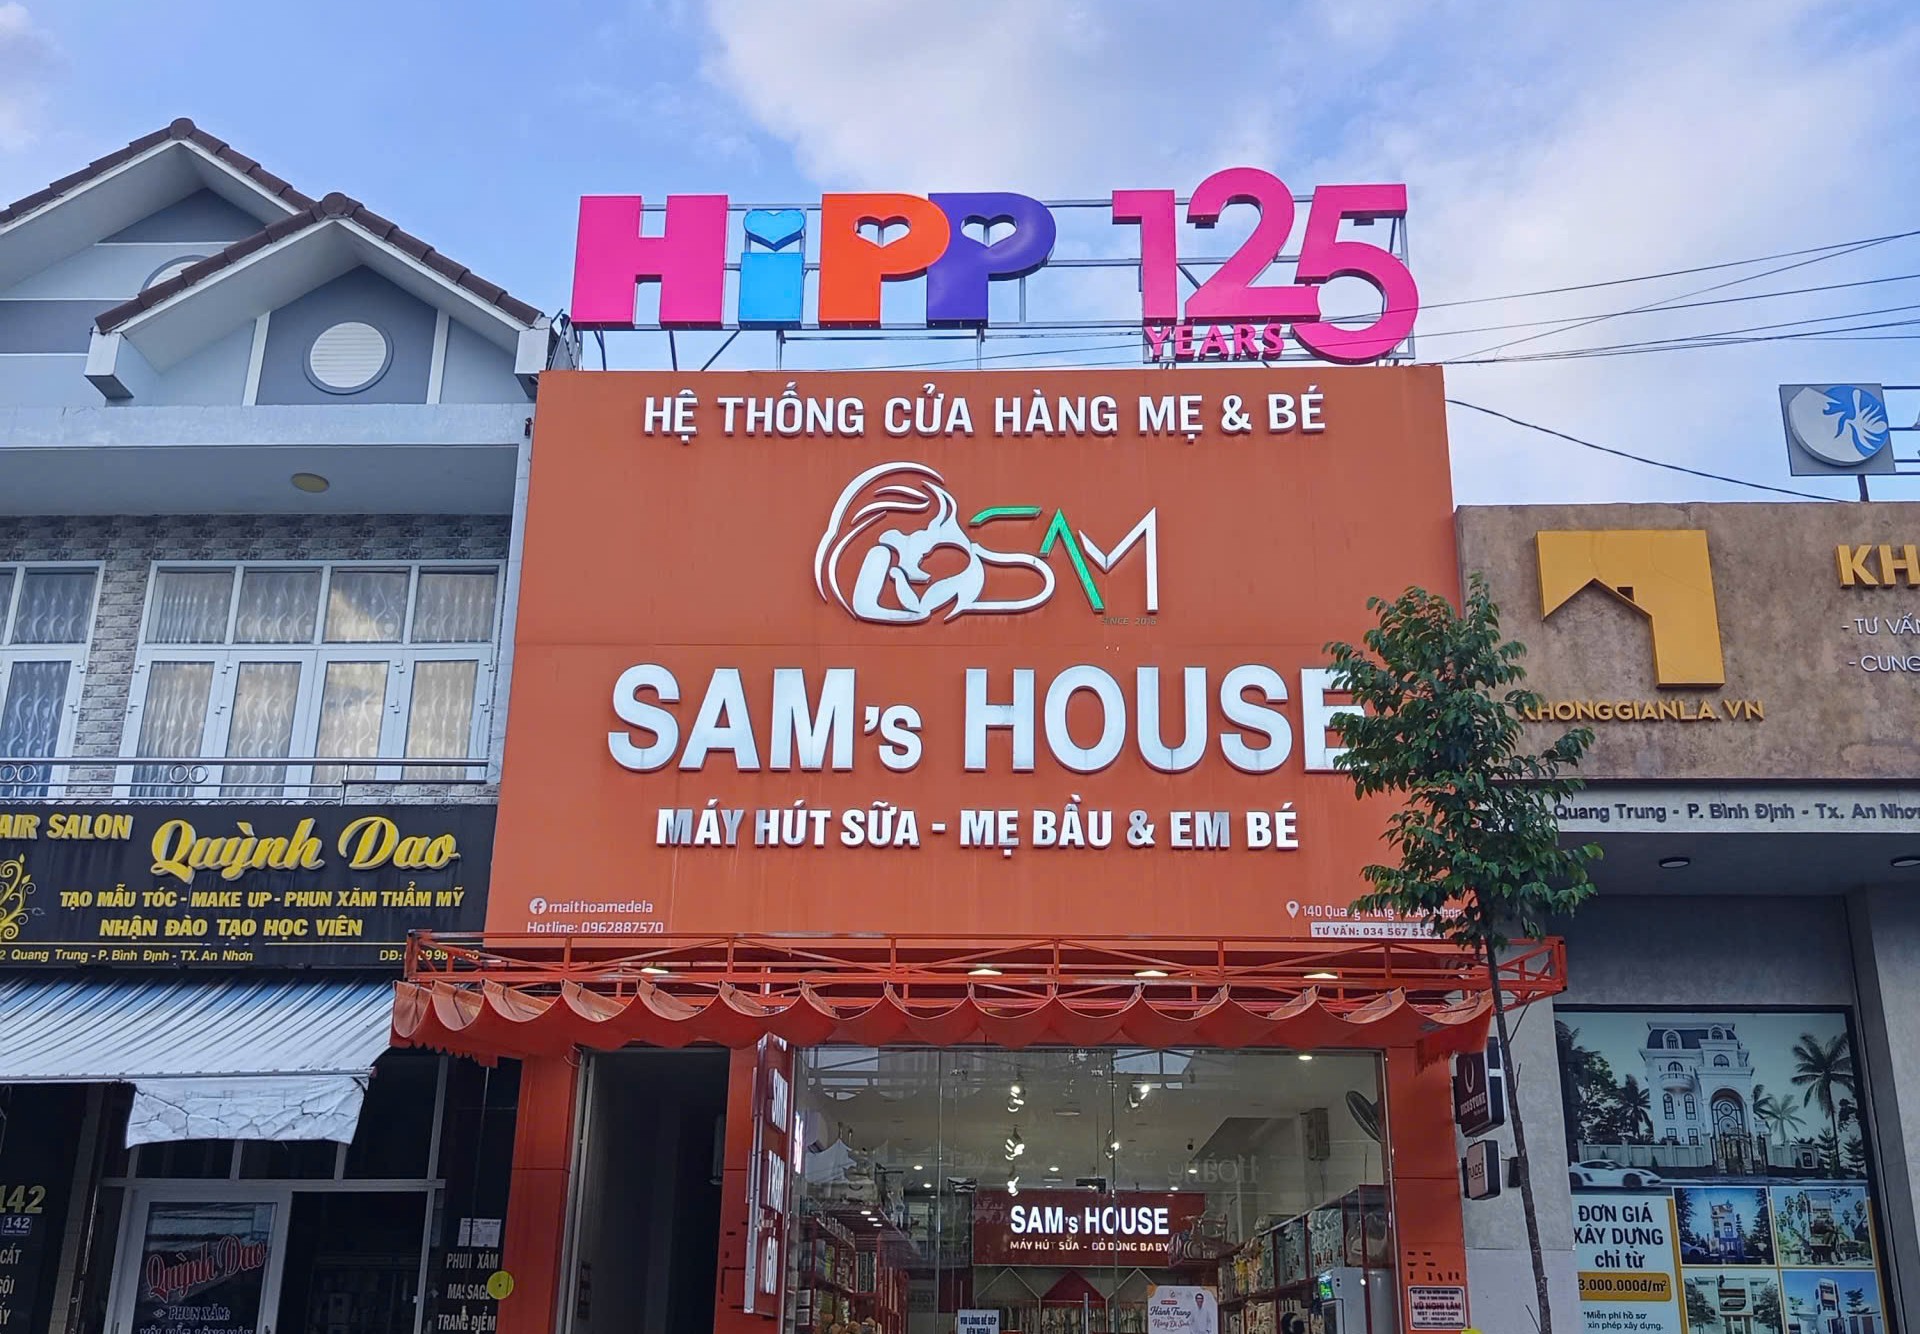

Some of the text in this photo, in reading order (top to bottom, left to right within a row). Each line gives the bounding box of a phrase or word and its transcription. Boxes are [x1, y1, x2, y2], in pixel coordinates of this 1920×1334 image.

[1112, 167, 1419, 365] 125
[1143, 323, 1285, 361] YEARS
[644, 381, 1326, 443] HỆ THỐNG CỬA HÀNG MẸ & BÉ
[968, 506, 1159, 616] SAM
[1854, 616, 1879, 634] TƯ
[1860, 655, 1920, 673] CUNG
[607, 663, 1370, 774] SAM's HOUSE
[1552, 803, 1609, 822] Quang
[1615, 803, 1666, 822] Trung
[1687, 804, 1704, 819] P.
[1709, 803, 1749, 819] Bình
[1754, 803, 1795, 822] Định
[1814, 804, 1845, 819] Tx.
[1851, 804, 1877, 819] An
[47, 814, 133, 840] SALON
[655, 798, 745, 848] MÁY
[754, 799, 832, 848] HÚT
[839, 800, 920, 848] SỮA
[959, 810, 1019, 858] MẸ
[1032, 793, 1112, 849] BẦU
[1126, 810, 1155, 849] &
[1170, 811, 1230, 849] EM
[1246, 802, 1299, 850] BÉ
[150, 815, 461, 884] Quỳnh Dao
[60, 891, 93, 911] TẠO
[97, 883, 137, 907] MẪU
[142, 887, 177, 907] TÓC
[190, 891, 242, 907] MAKE
[247, 891, 272, 908] UP
[284, 891, 333, 907] PHUN
[336, 887, 377, 907] XĂM
[380, 881, 431, 907] THẨM
[435, 886, 465, 907] MỸ
[549, 900, 653, 913] maithoamedela
[1302, 905, 1322, 917] 140
[1325, 905, 1361, 921] Quag
[99, 915, 363, 940] NHẬN ĐÀO TẠO HỌC VIÊN
[527, 922, 664, 934] Hotline: 0962887570
[1315, 926, 1331, 936] TƯ
[1333, 924, 1359, 937] VẤN:
[1363, 928, 1383, 936] 034
[1388, 928, 1408, 936] 567
[11, 950, 49, 963] Quang
[55, 950, 88, 963] Trung
[98, 950, 109, 961] P.
[112, 949, 138, 961] Bình
[143, 950, 169, 963] Định
[180, 950, 200, 961] TX.
[201, 950, 218, 961] An
[222, 950, 253, 961] Nhơn
[5, 1217, 30, 1229] 142
[1010, 1205, 1079, 1234] SAM's
[1085, 1206, 1170, 1235] HOUSE
[1578, 1202, 1653, 1223] ĐƠN GIÁ
[1010, 1238, 1033, 1250] MÁY
[1140, 1243, 1169, 1252] BABY
[1574, 1223, 1664, 1249] XÂY DỰNG
[0, 1242, 22, 1264] CẮT
[477, 1250, 499, 1269] XĂM
[1595, 1249, 1645, 1268] chỉ từ
